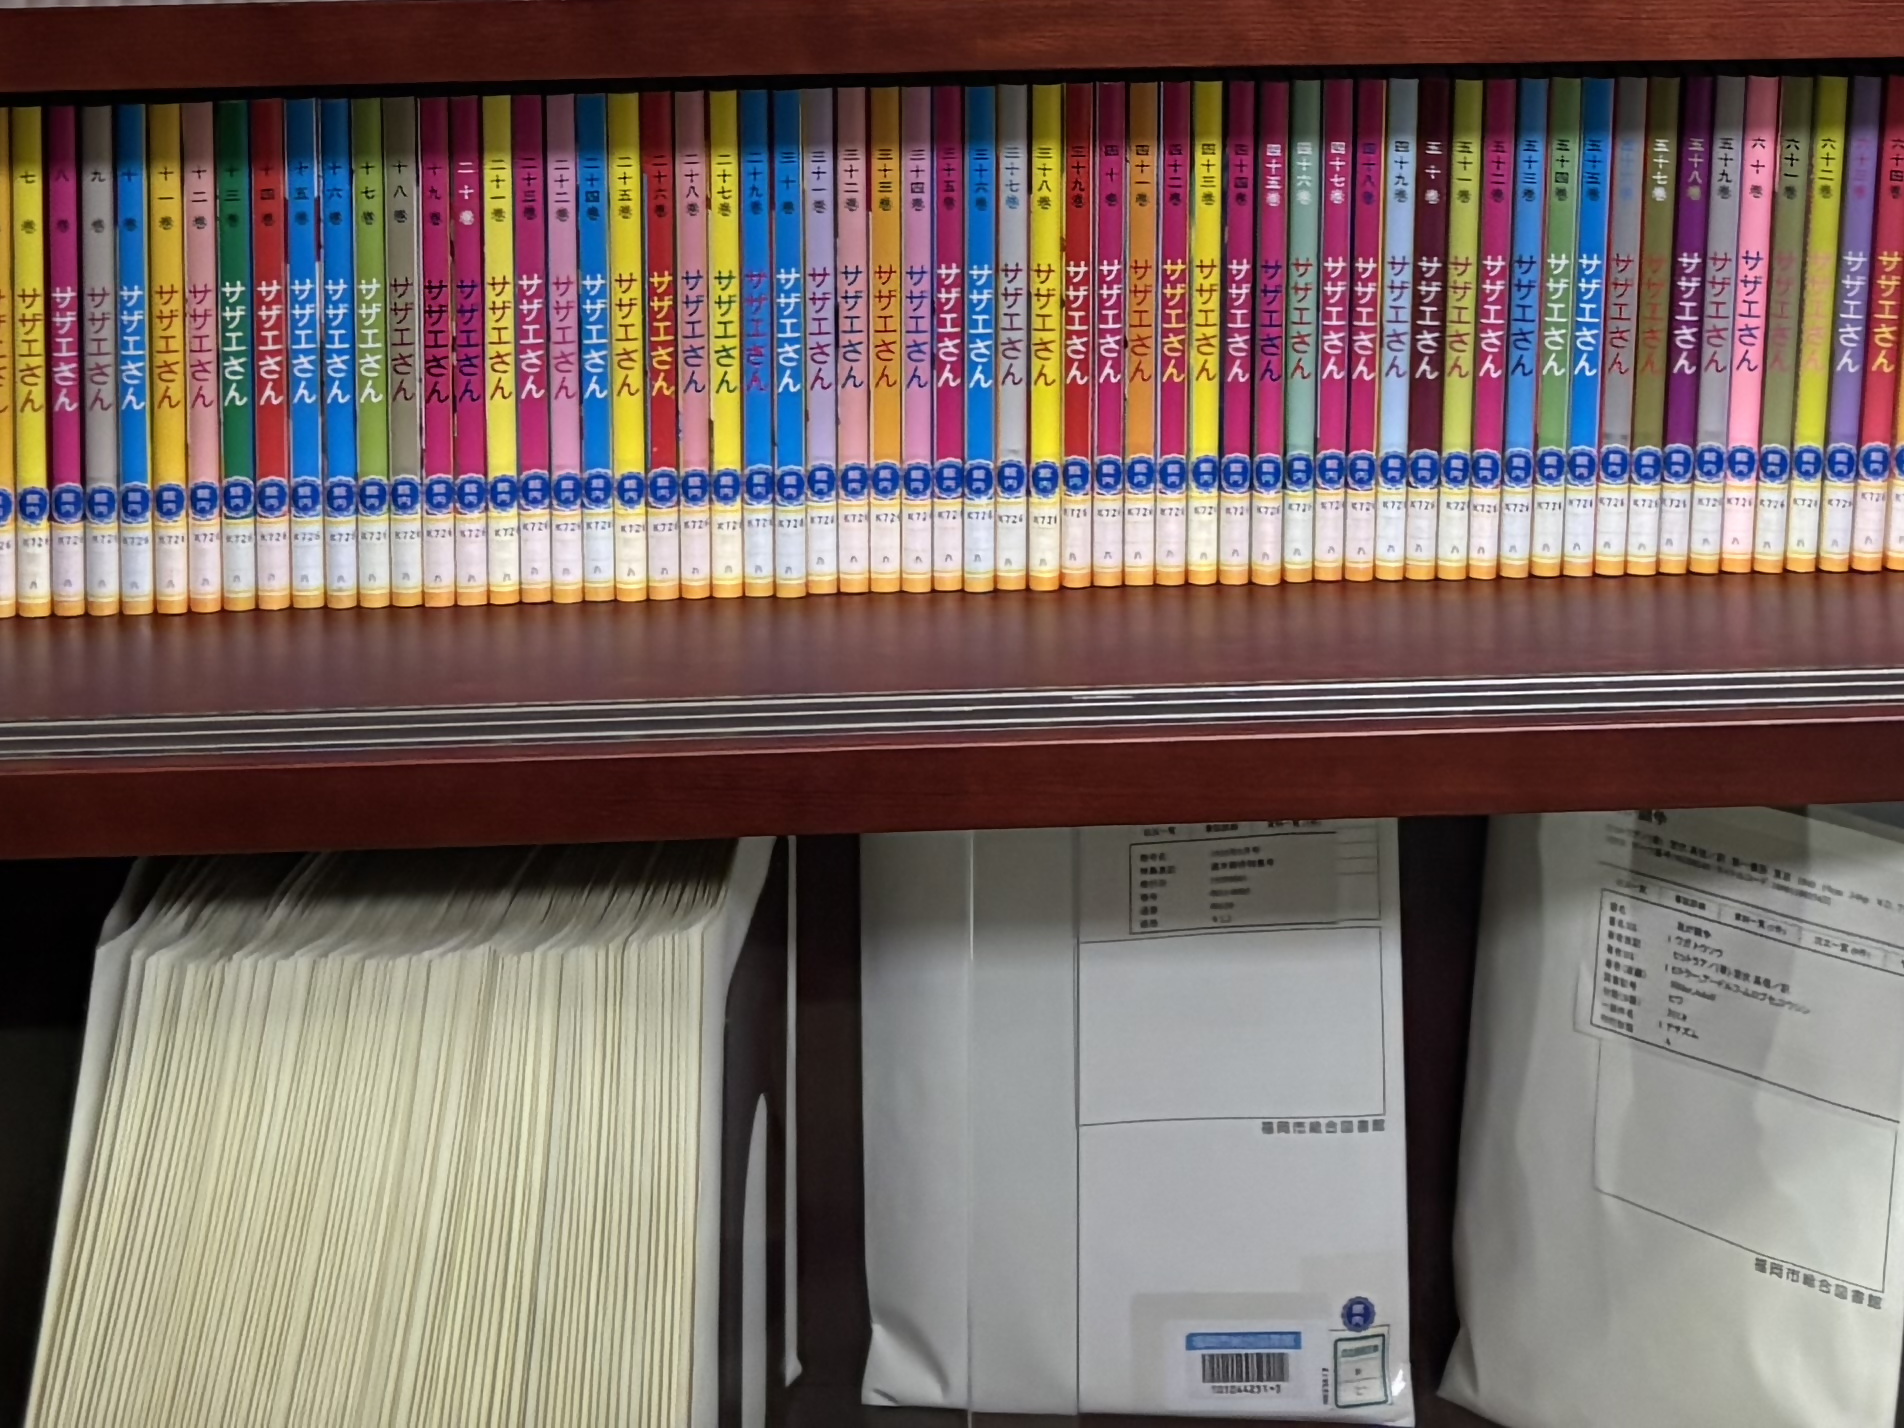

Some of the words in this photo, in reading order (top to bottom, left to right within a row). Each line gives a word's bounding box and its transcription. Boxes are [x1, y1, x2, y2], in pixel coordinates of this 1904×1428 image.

[51, 286, 79, 412] サザエさん
[257, 280, 284, 408] サザエさん
[582, 273, 609, 400] サザエさん
[969, 263, 994, 389] サザエさん
